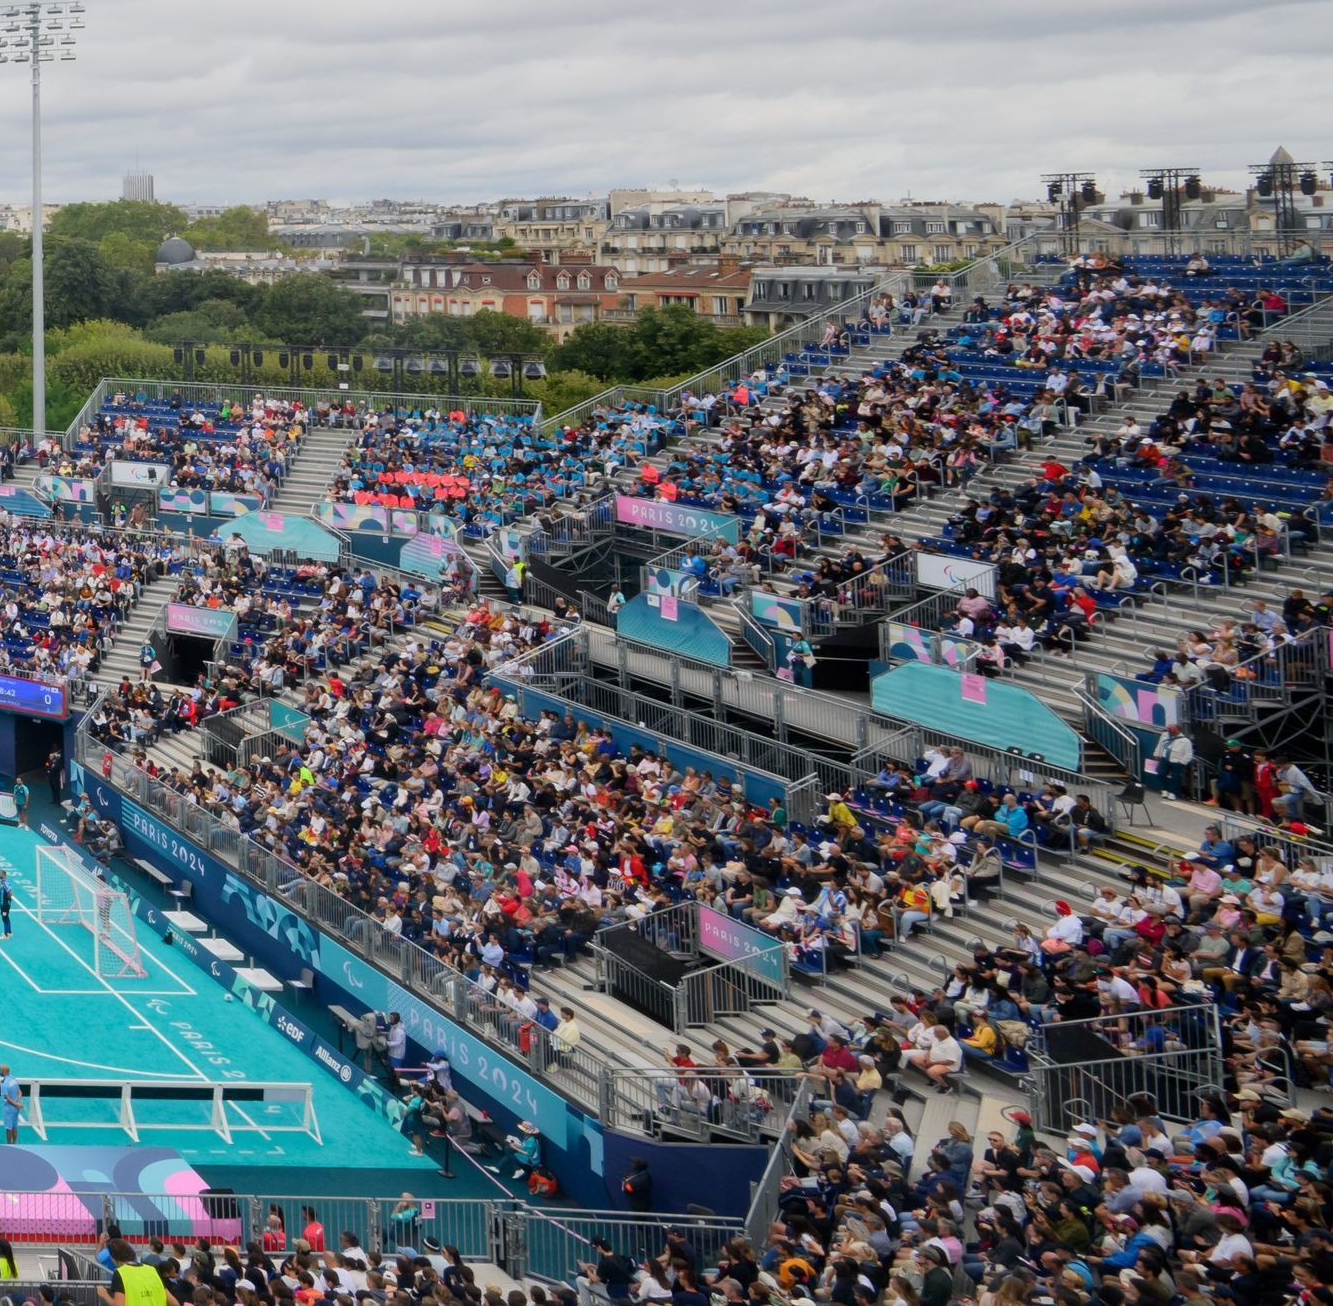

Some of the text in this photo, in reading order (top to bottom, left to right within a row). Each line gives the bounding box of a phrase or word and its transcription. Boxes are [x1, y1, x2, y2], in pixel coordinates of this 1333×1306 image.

[632, 505, 719, 533] PARIS 2024
[0, 687, 15, 696] 8:42
[45, 695, 51, 704] 0
[41, 823, 57, 843] TOYOTA
[134, 813, 205, 876] PARIS 2024
[705, 922, 740, 947] PARIS
[169, 1022, 231, 1066] PARIS
[315, 1046, 342, 1074] Allianz
[410, 1008, 537, 1116] PARIS 2024
